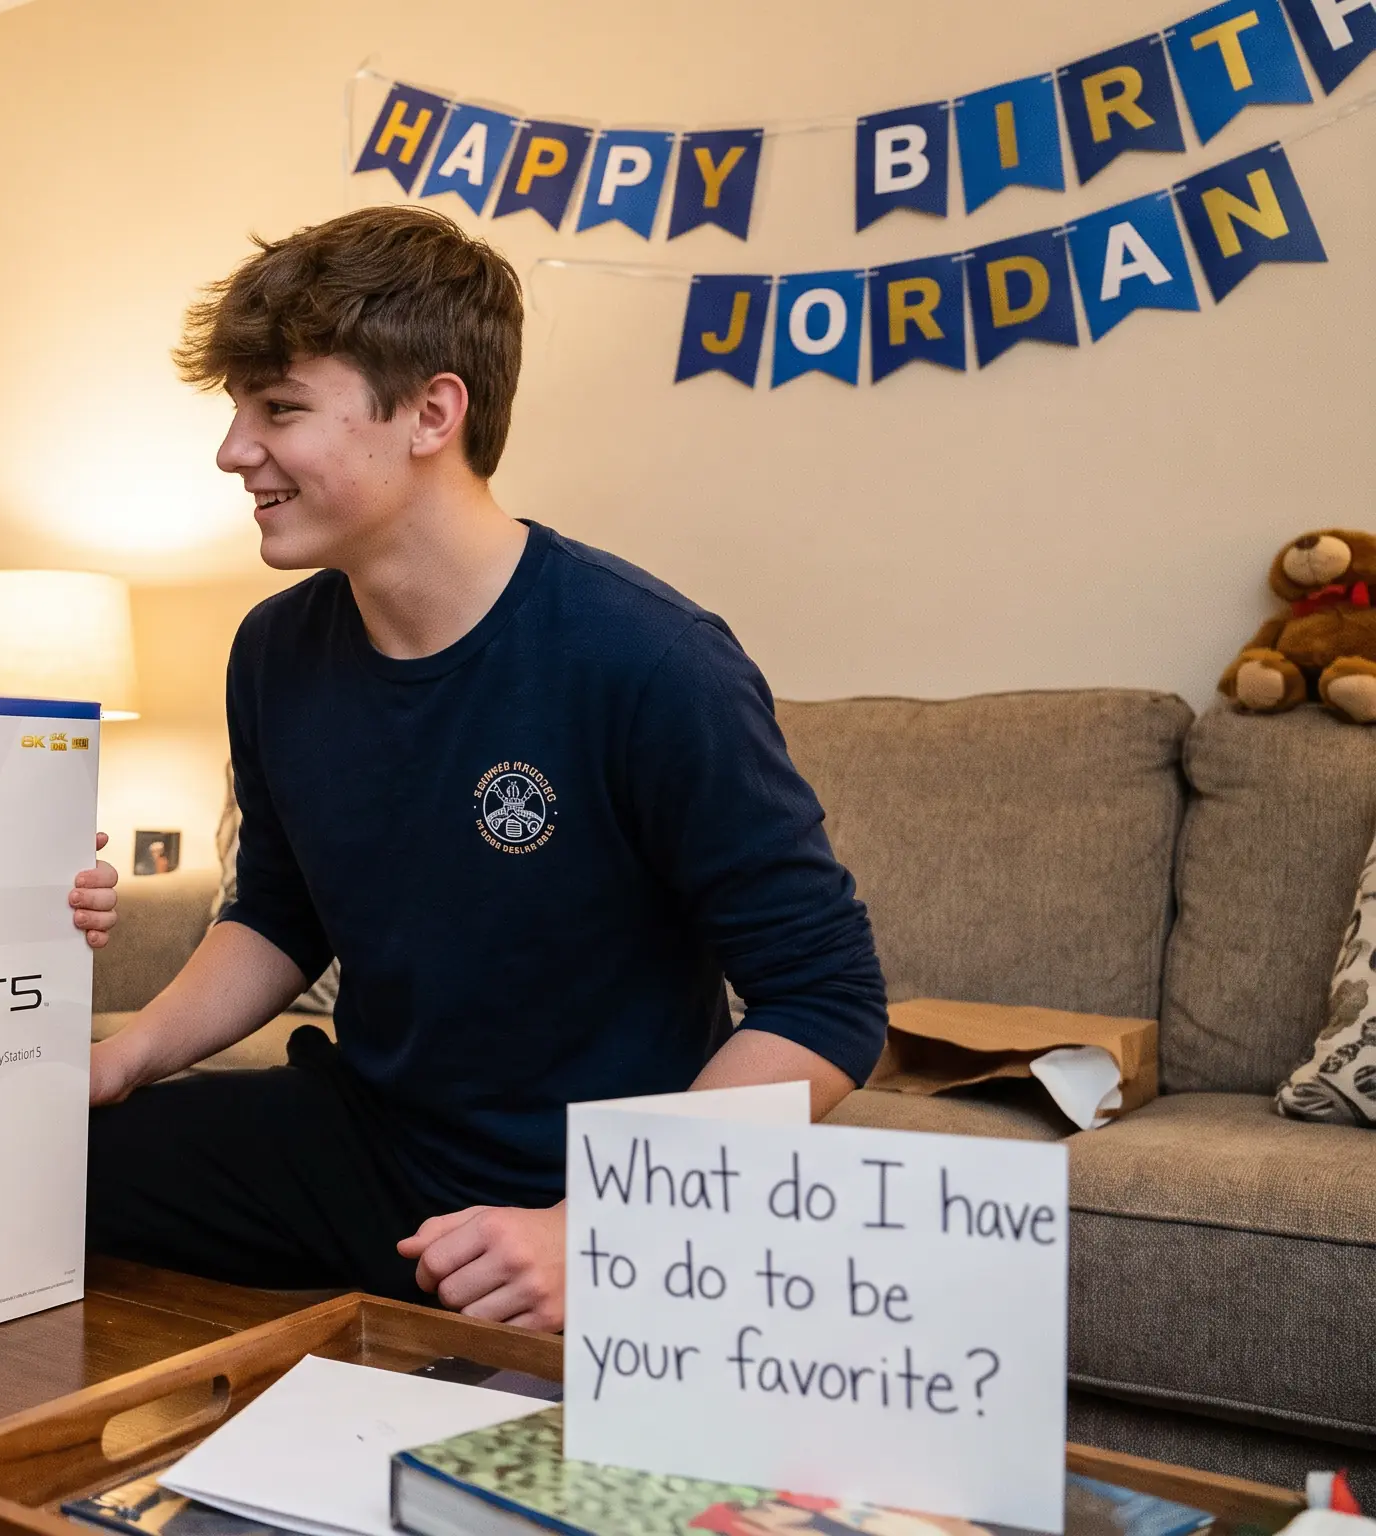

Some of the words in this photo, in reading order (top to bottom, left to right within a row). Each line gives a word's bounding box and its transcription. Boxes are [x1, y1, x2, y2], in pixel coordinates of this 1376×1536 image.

[374, 99, 747, 209] HAPPY
[700, 168, 1291, 356] JORDAN
[583, 1134, 740, 1213] What
[768, 1152, 836, 1221] do
[861, 1159, 905, 1229] I
[940, 1167, 1057, 1246] have
[580, 1228, 636, 1289] to
[664, 1240, 726, 1300] do
[756, 1249, 815, 1310] to
[848, 1257, 913, 1323] be
[582, 1335, 700, 1401] your
[727, 1326, 1000, 1418] favorite?
